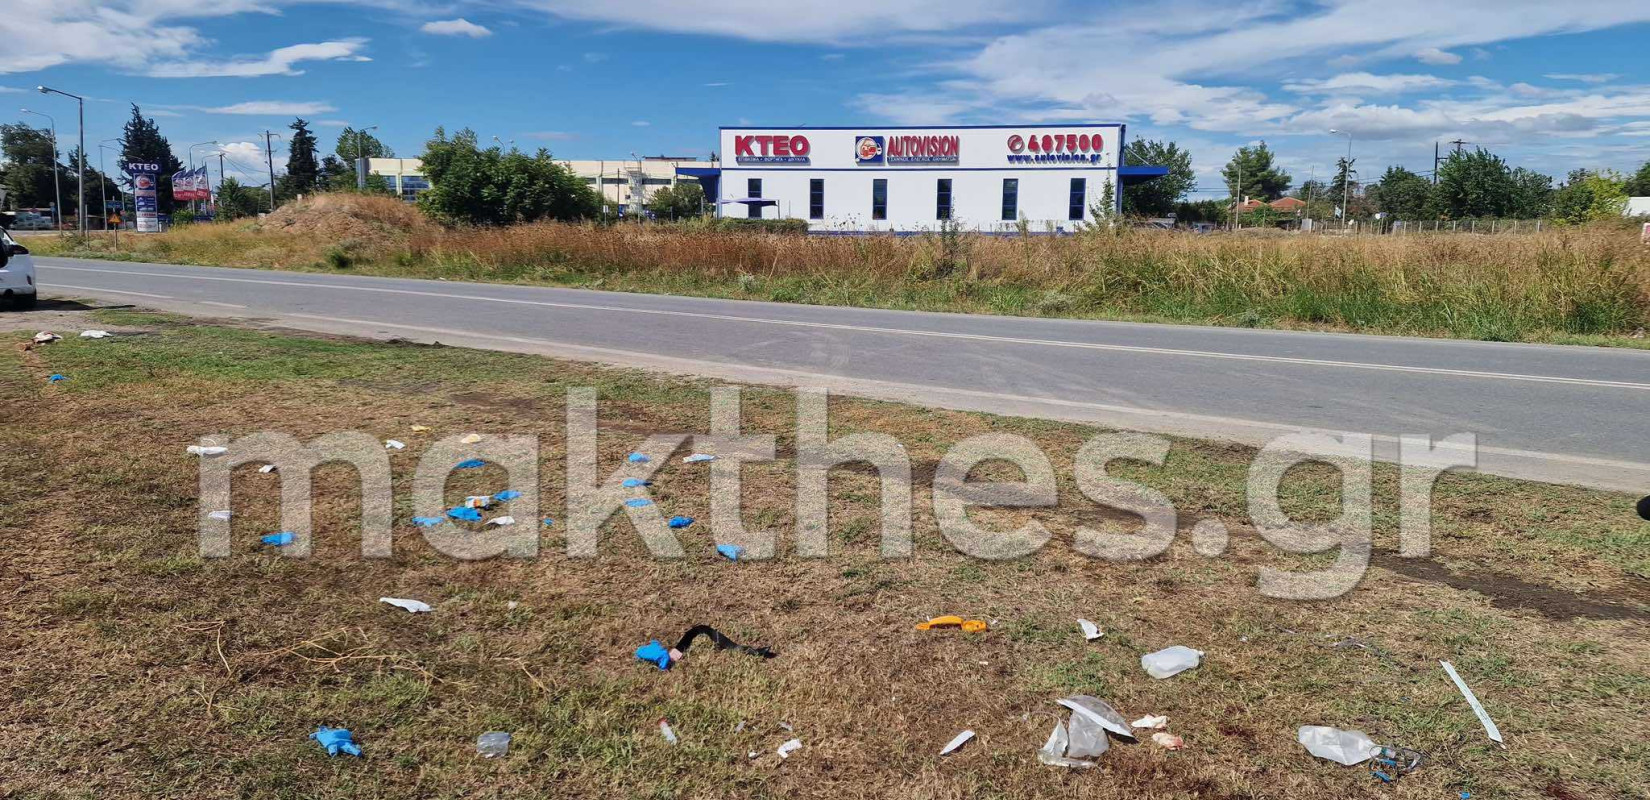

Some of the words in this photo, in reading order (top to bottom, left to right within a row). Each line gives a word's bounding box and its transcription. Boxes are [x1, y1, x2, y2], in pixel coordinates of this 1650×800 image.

[735, 135, 809, 156] ΚΤΕΟ
[887, 135, 959, 157] AUTOVISION
[1007, 152, 1101, 164] www.autovision.gr
